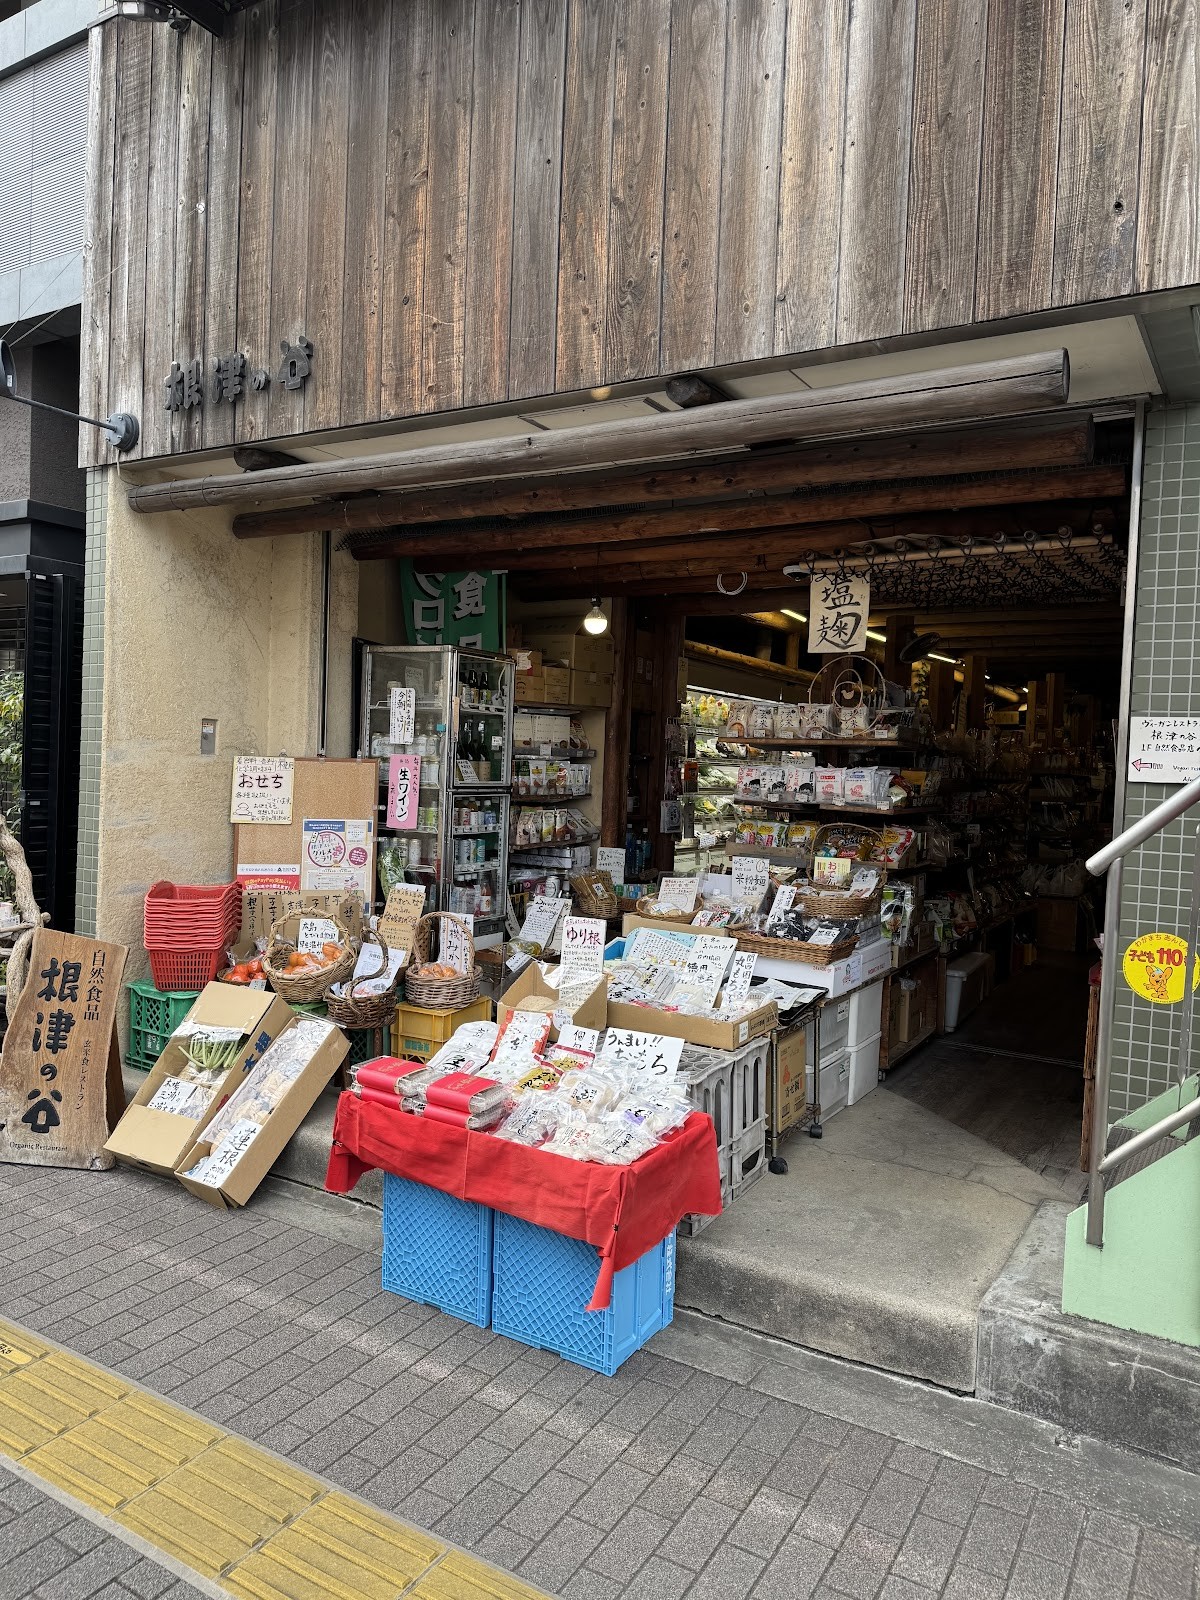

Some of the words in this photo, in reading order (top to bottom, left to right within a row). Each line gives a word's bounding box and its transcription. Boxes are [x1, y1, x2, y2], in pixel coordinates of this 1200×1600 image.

[163, 335, 311, 412] 根津の谷
[1151, 730, 1197, 741] 根津の谷
[238, 773, 284, 789] おせち
[397, 768, 410, 818] 生ワイン
[535, 896, 557, 907] Sweet
[536, 905, 559, 920] Spring
[566, 926, 603, 946] ゆり根
[83, 949, 107, 1021] 自然食品
[21, 957, 82, 1134] 根津の谷
[74, 1039, 91, 1111] 玄米食レストラン
[9, 1141, 35, 1151] Organic
